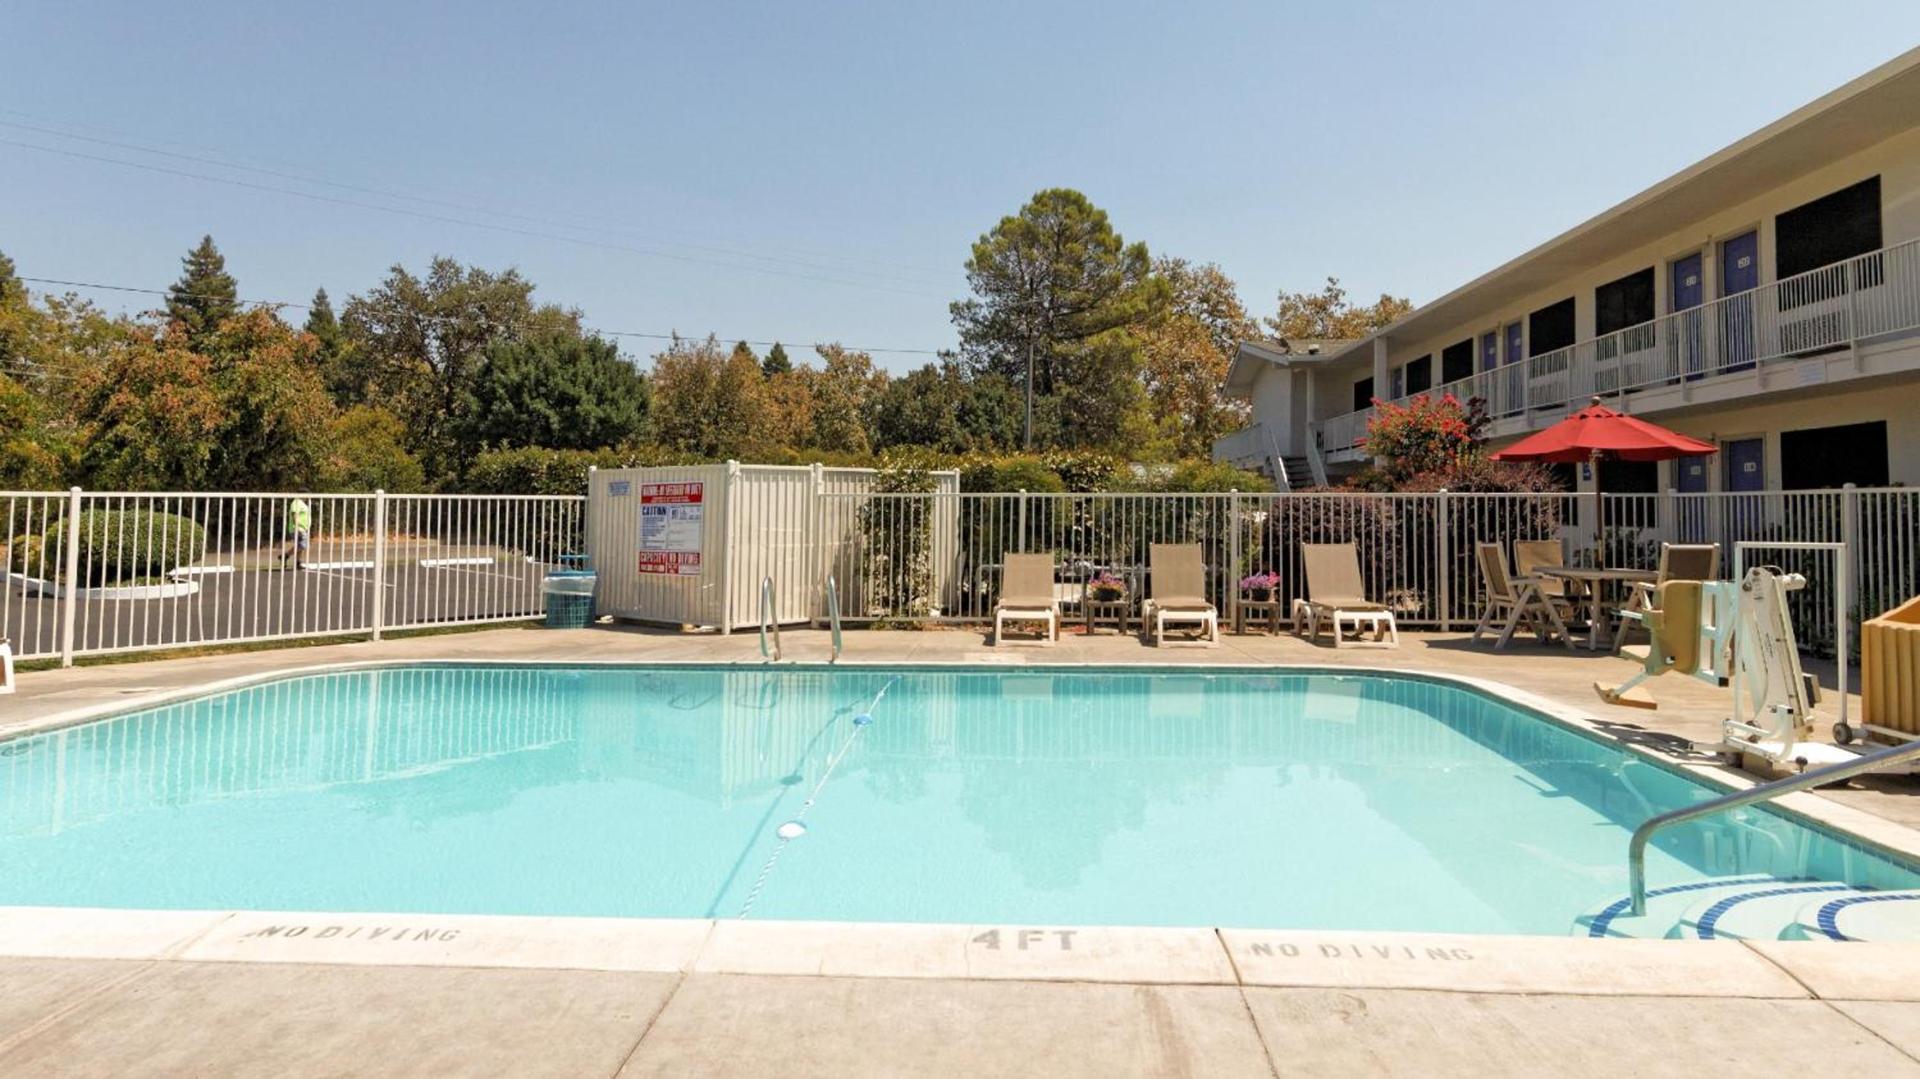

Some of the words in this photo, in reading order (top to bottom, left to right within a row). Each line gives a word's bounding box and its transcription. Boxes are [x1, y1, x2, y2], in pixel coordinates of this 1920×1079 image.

[255, 925, 310, 938] NO
[313, 926, 461, 942] DIVING
[1252, 942, 1300, 958] NO
[1320, 943, 1475, 962] DIVING
